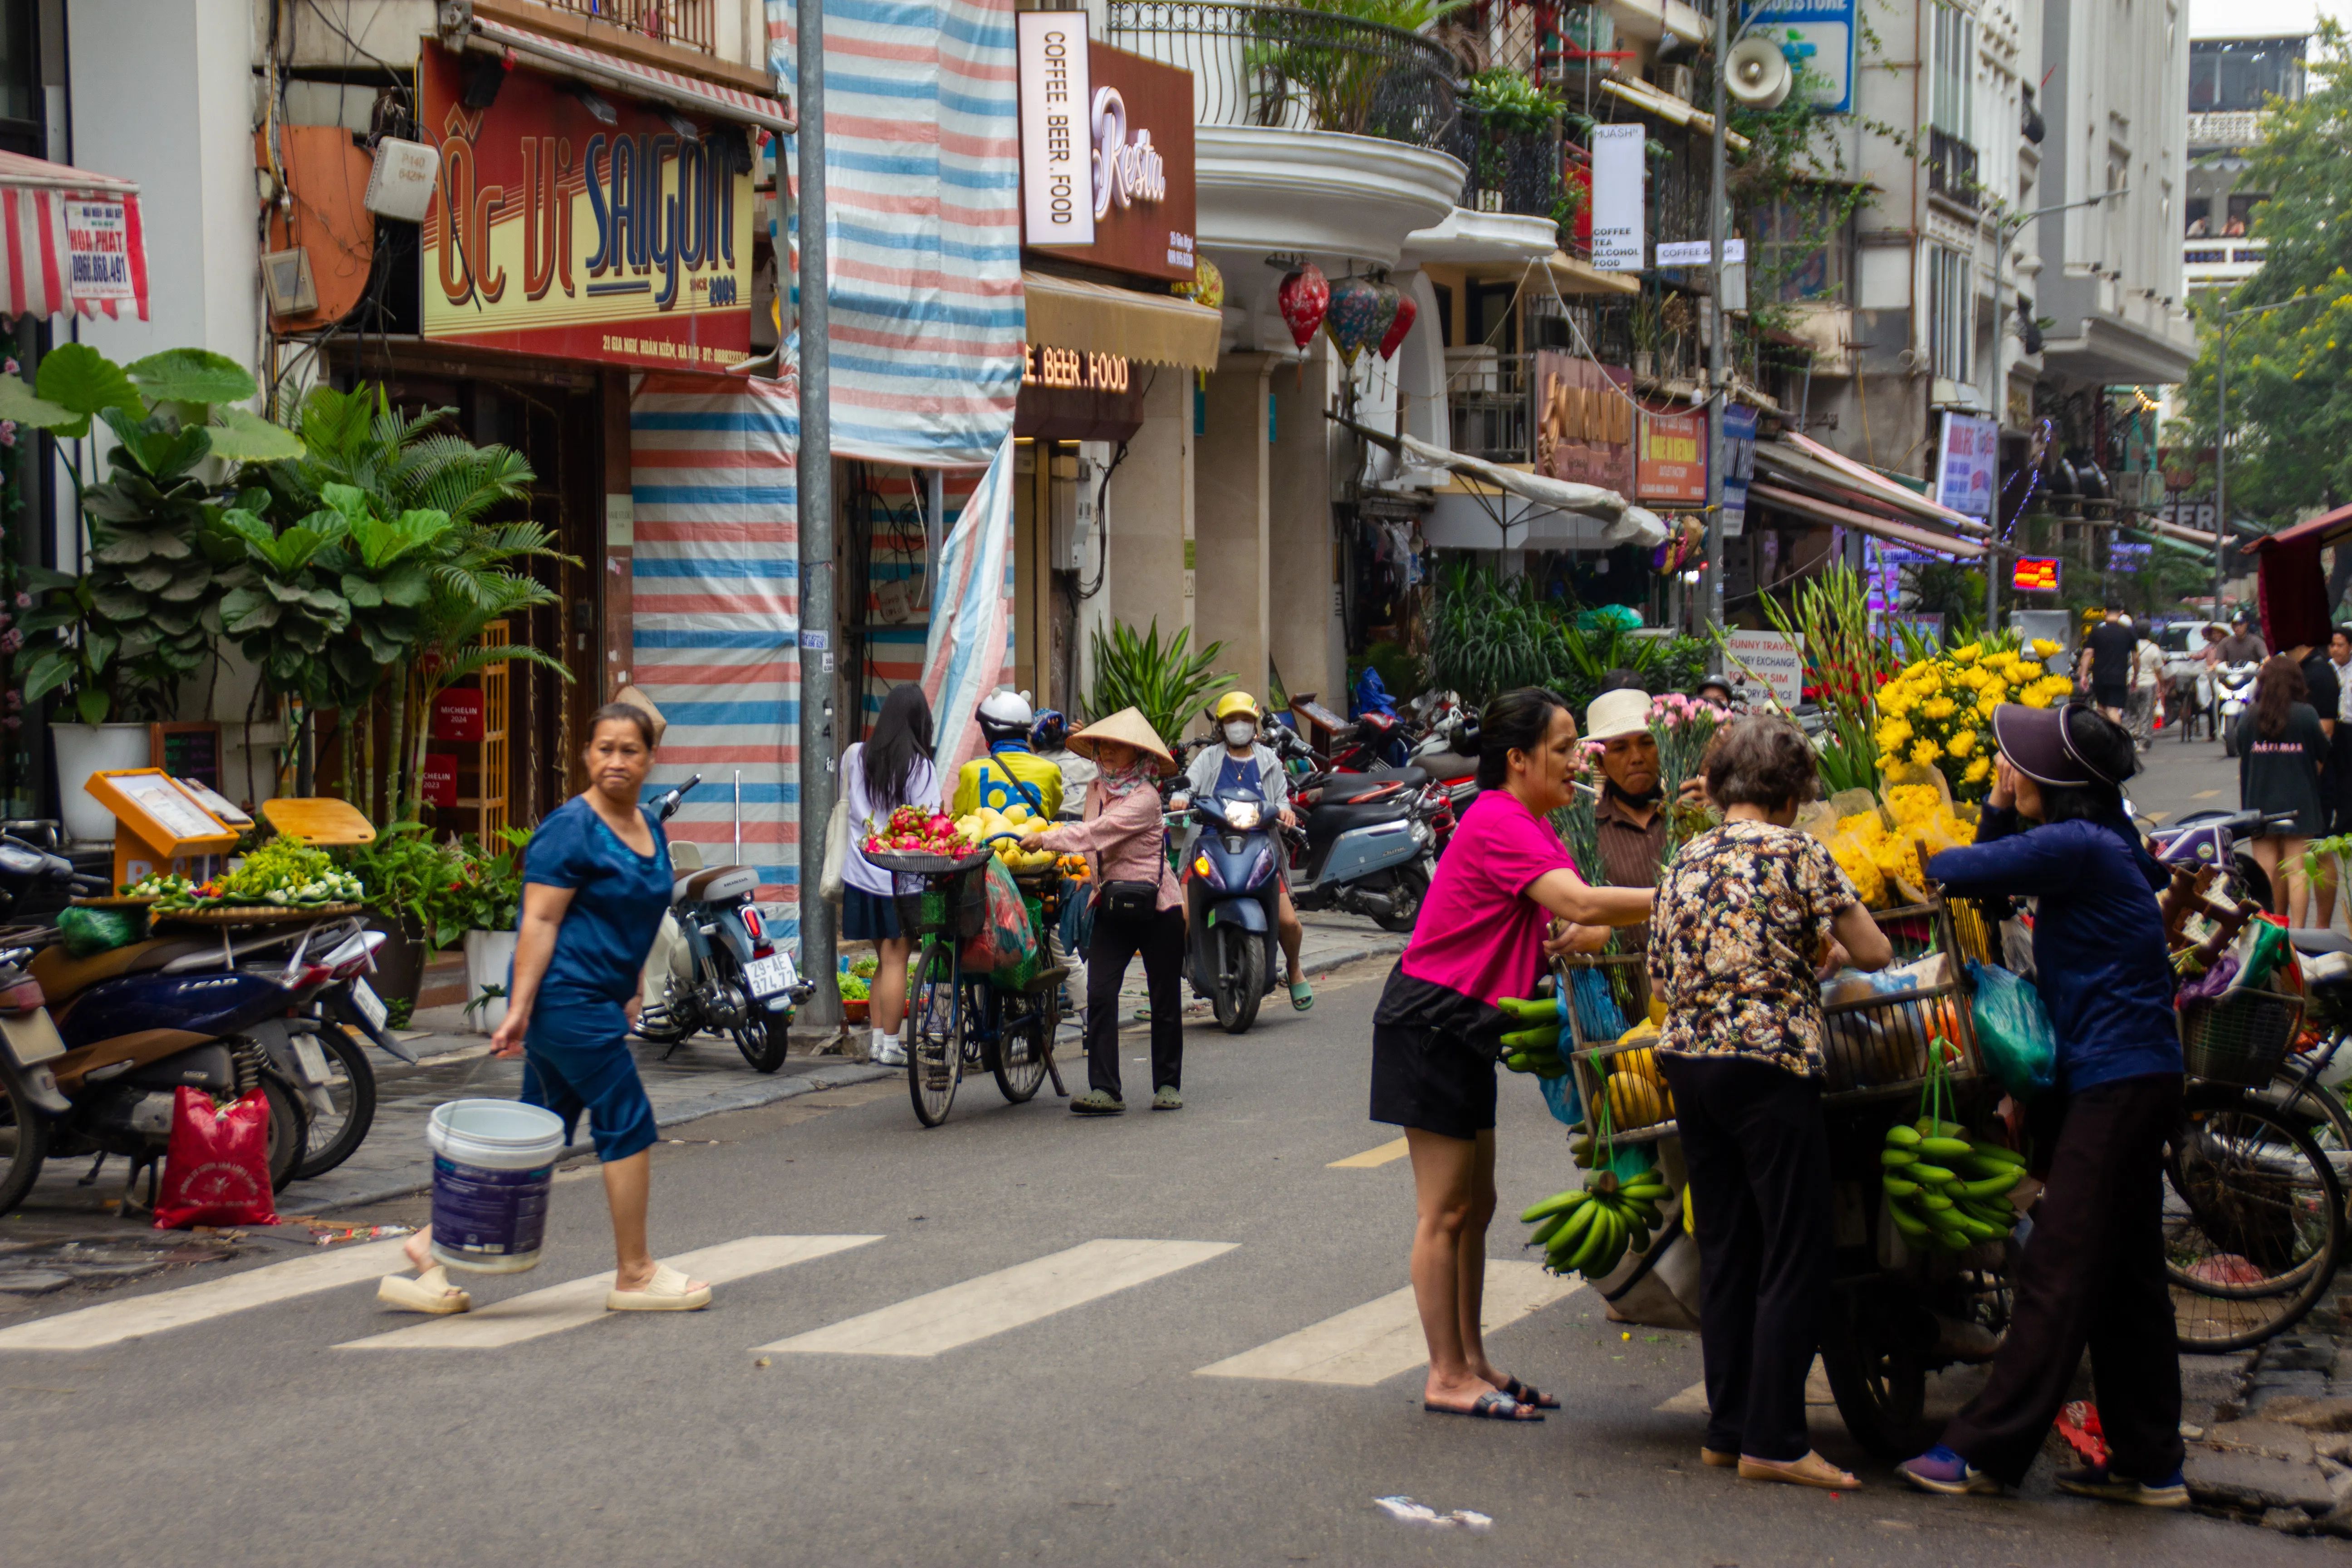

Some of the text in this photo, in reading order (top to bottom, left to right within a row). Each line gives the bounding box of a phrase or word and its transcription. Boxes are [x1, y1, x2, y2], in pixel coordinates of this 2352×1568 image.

[1044, 30, 1073, 225] COFFEE BEER FOOD
[1092, 86, 1166, 222] Resta
[1593, 227, 1632, 235] COFFEE
[1593, 248, 1640, 257] ALCOHOL
[1662, 247, 1701, 258] COFFEE
[690, 274, 737, 307] SINCE 2009
[612, 336, 622, 352] GIA
[678, 340, 687, 360] HÀ
[1044, 345, 1081, 387] BEER
[1090, 350, 1128, 391] FOOD
[1650, 435, 1666, 460] MADE
[1667, 436, 1673, 460] IN
[1673, 436, 1697, 462] VIETNAM
[2157, 504, 2216, 530] EER
[1730, 639, 1761, 650] FUNNY
[1729, 654, 1796, 667] ONEY EXCHANGE
[1770, 673, 1788, 684] SIM
[1763, 689, 1793, 700] SEVICE
[441, 706, 477, 715] MICHELIN
[451, 715, 467, 723] 2024
[423, 781, 440, 789] 2023
[980, 766, 1042, 817] be
[724, 877, 748, 888] HONDA
[751, 954, 787, 978] 29-AE
[177, 978, 239, 995] LEAD
